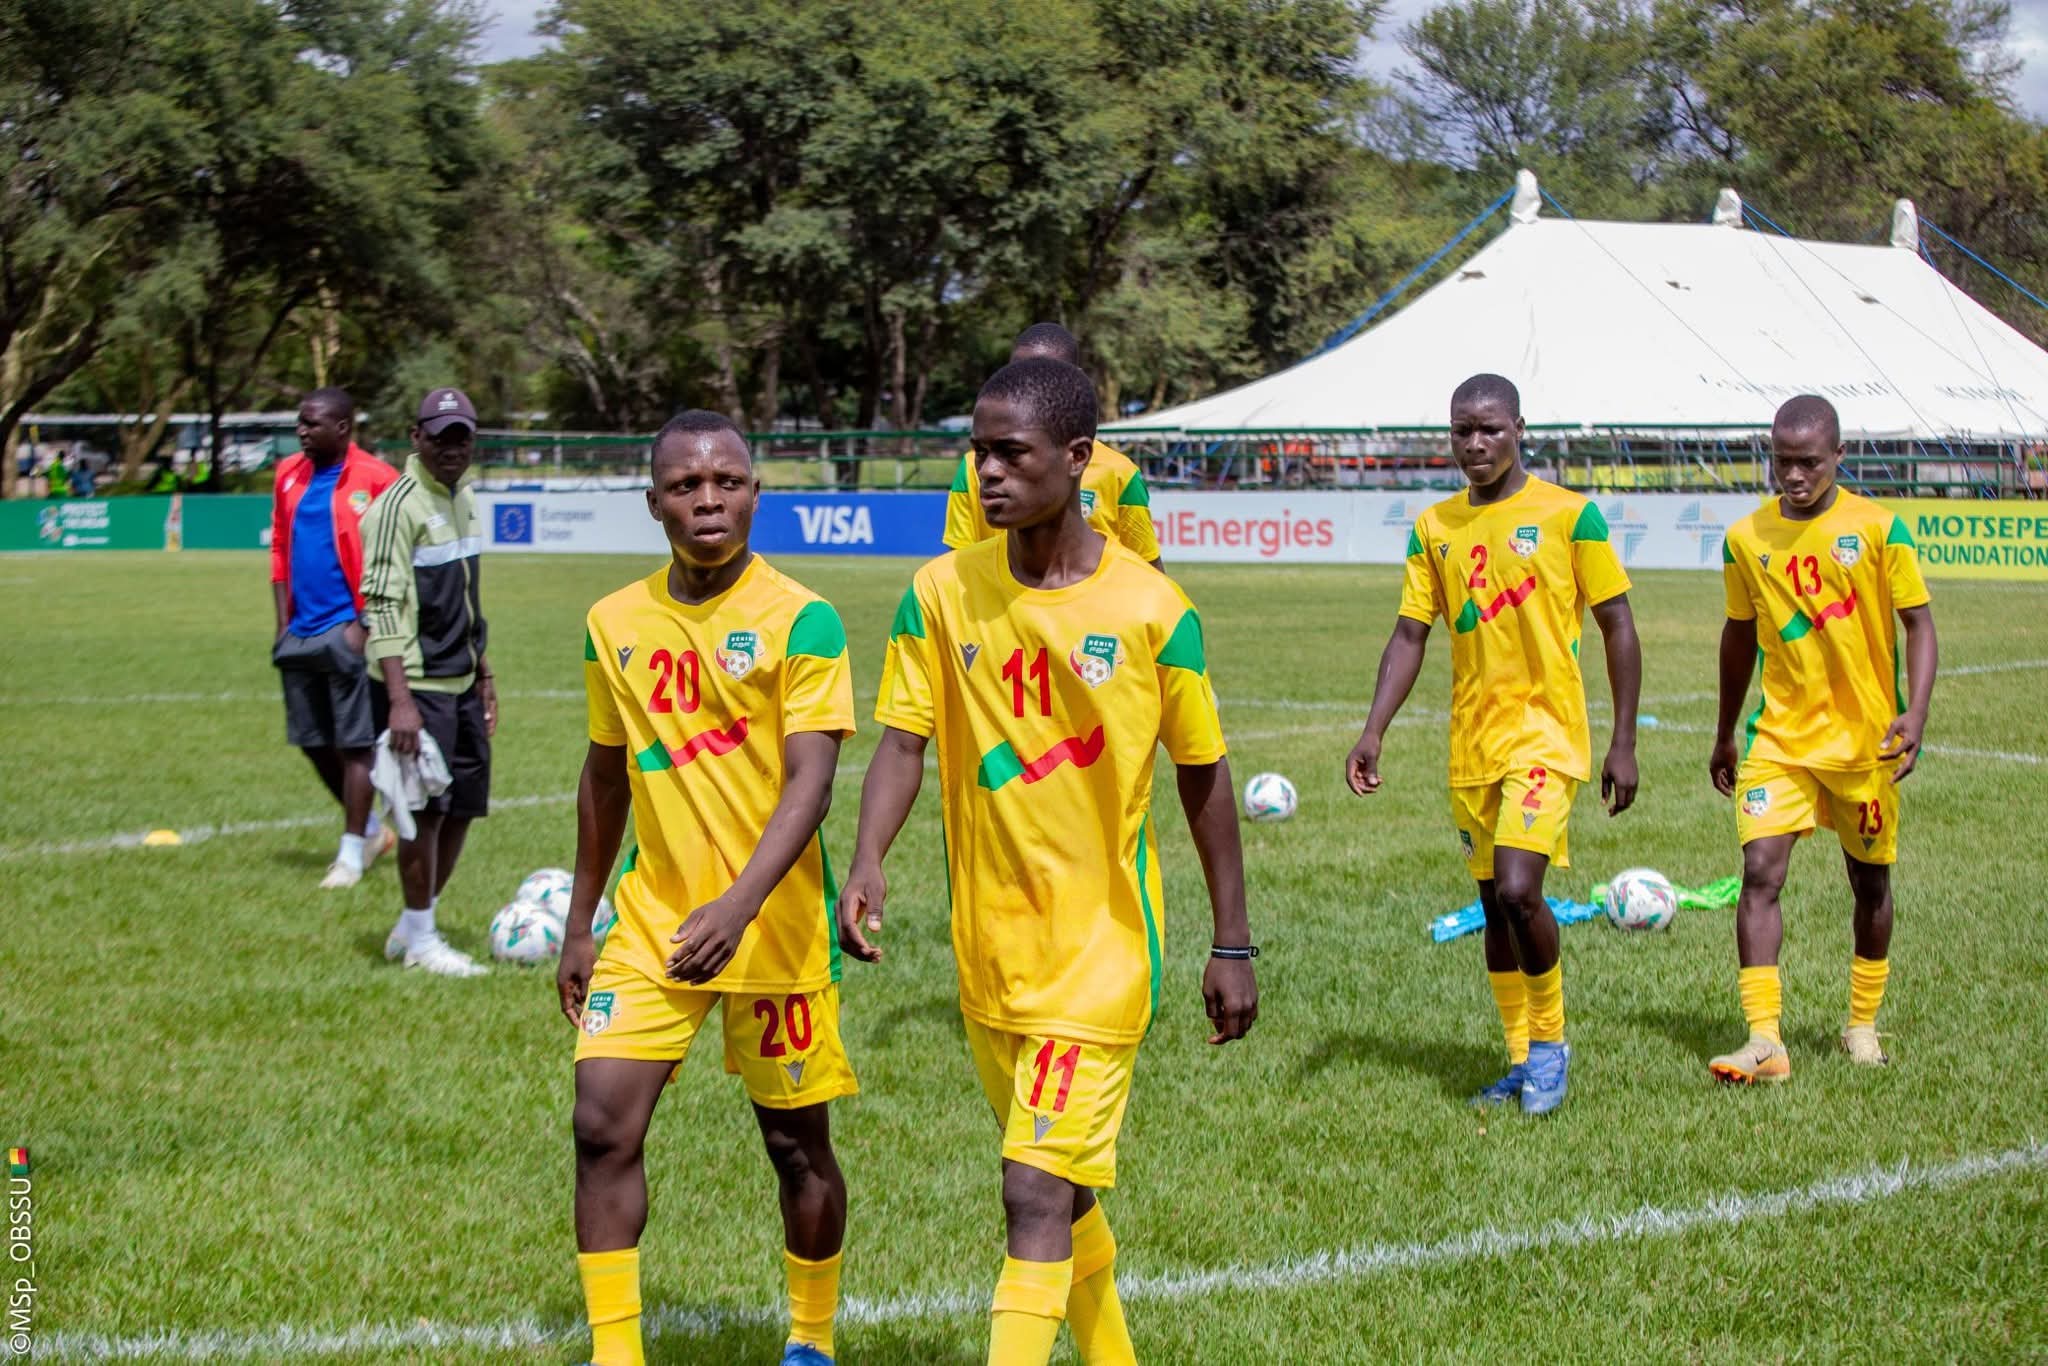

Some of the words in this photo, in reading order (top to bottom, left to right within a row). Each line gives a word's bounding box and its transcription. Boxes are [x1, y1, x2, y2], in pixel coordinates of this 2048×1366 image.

[792, 505, 875, 545] VISA
[1917, 514, 2048, 538] MOTSEPE
[1468, 545, 1488, 589] 2
[1784, 553, 1823, 597] 13
[1916, 543, 2048, 567] FOUNDATION
[647, 648, 701, 714] 20
[1002, 647, 1052, 718] 11
[1521, 766, 1547, 810] 2
[1858, 797, 1883, 836] 13
[753, 992, 813, 1058] 20
[1028, 1039, 1082, 1113] 11
